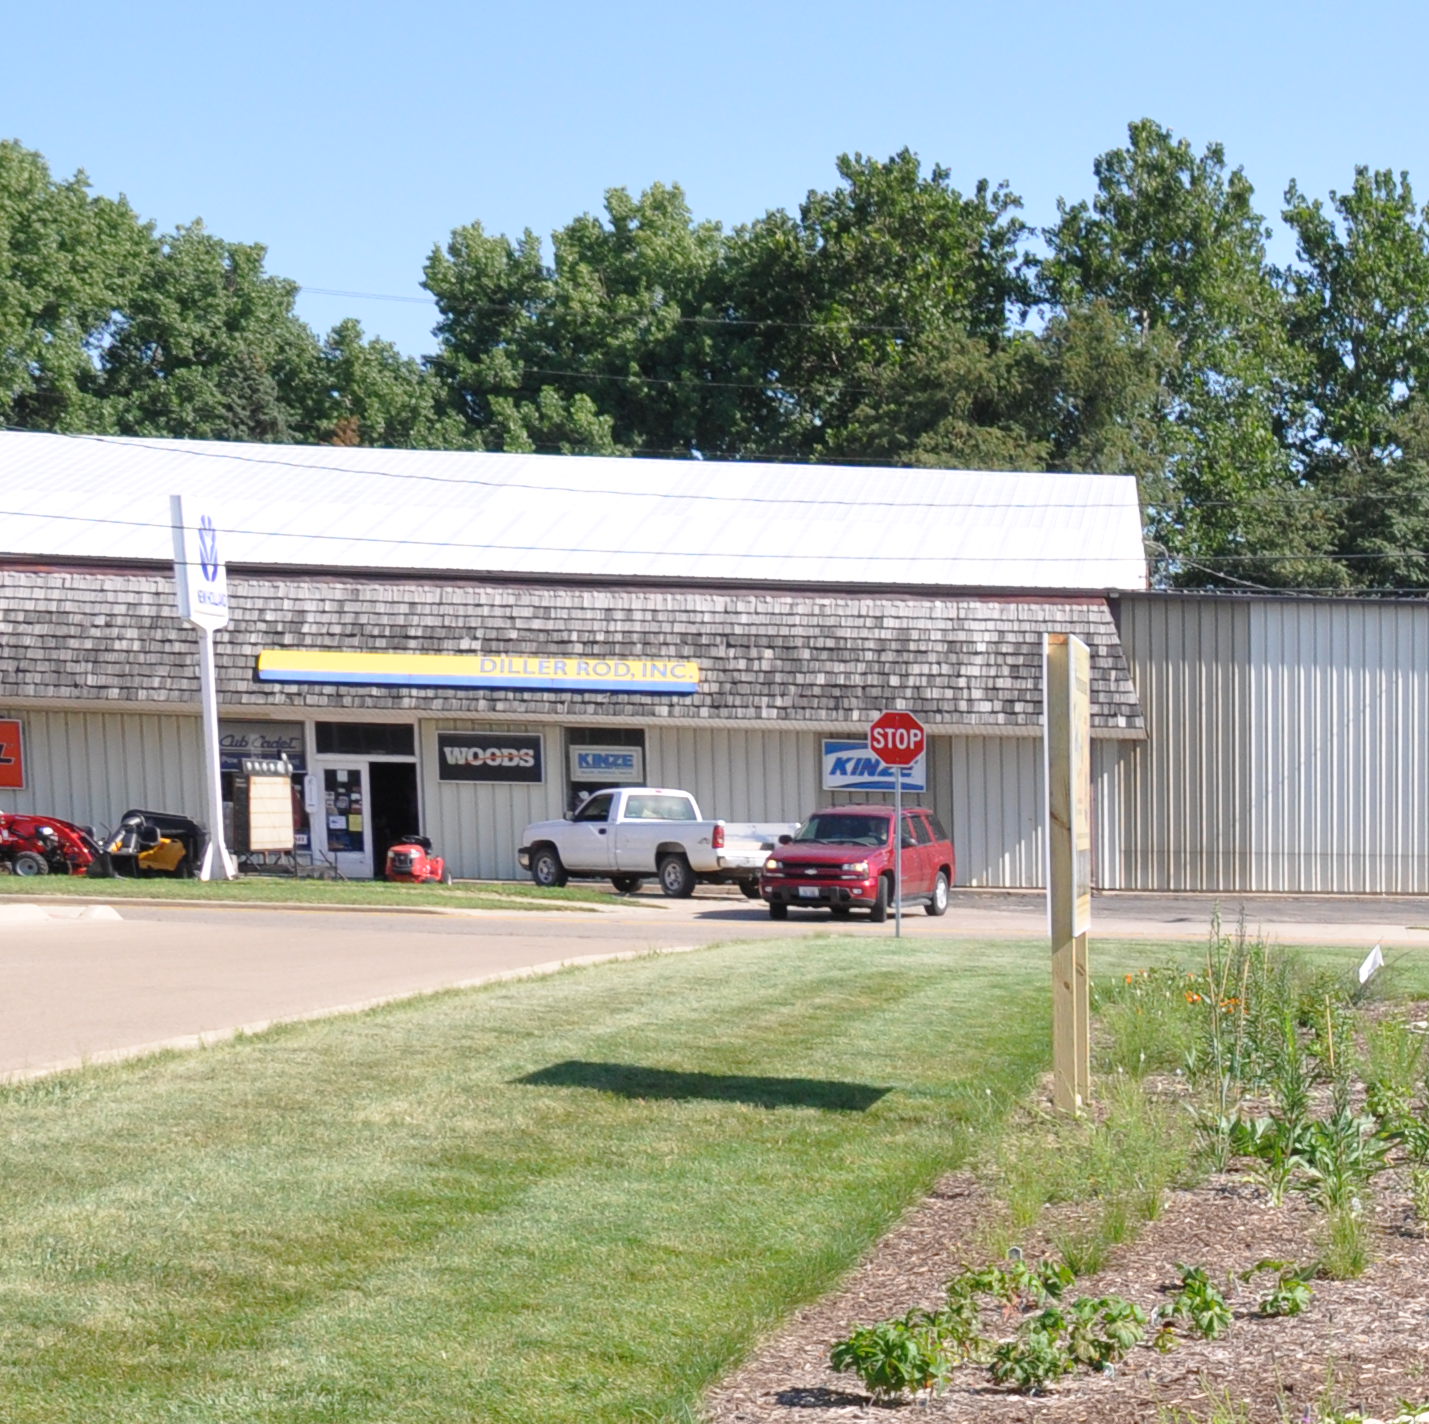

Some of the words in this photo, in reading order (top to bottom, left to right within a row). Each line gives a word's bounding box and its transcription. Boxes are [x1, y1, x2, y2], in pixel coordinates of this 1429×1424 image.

[480, 657, 568, 677] DILLER
[576, 661, 636, 679] ROD,
[642, 662, 695, 680] INC.
[220, 734, 249, 749] Cub
[251, 735, 302, 750] Cadet
[872, 727, 923, 750] STOP
[443, 746, 535, 768] WOODS
[577, 752, 635, 770] KINZE
